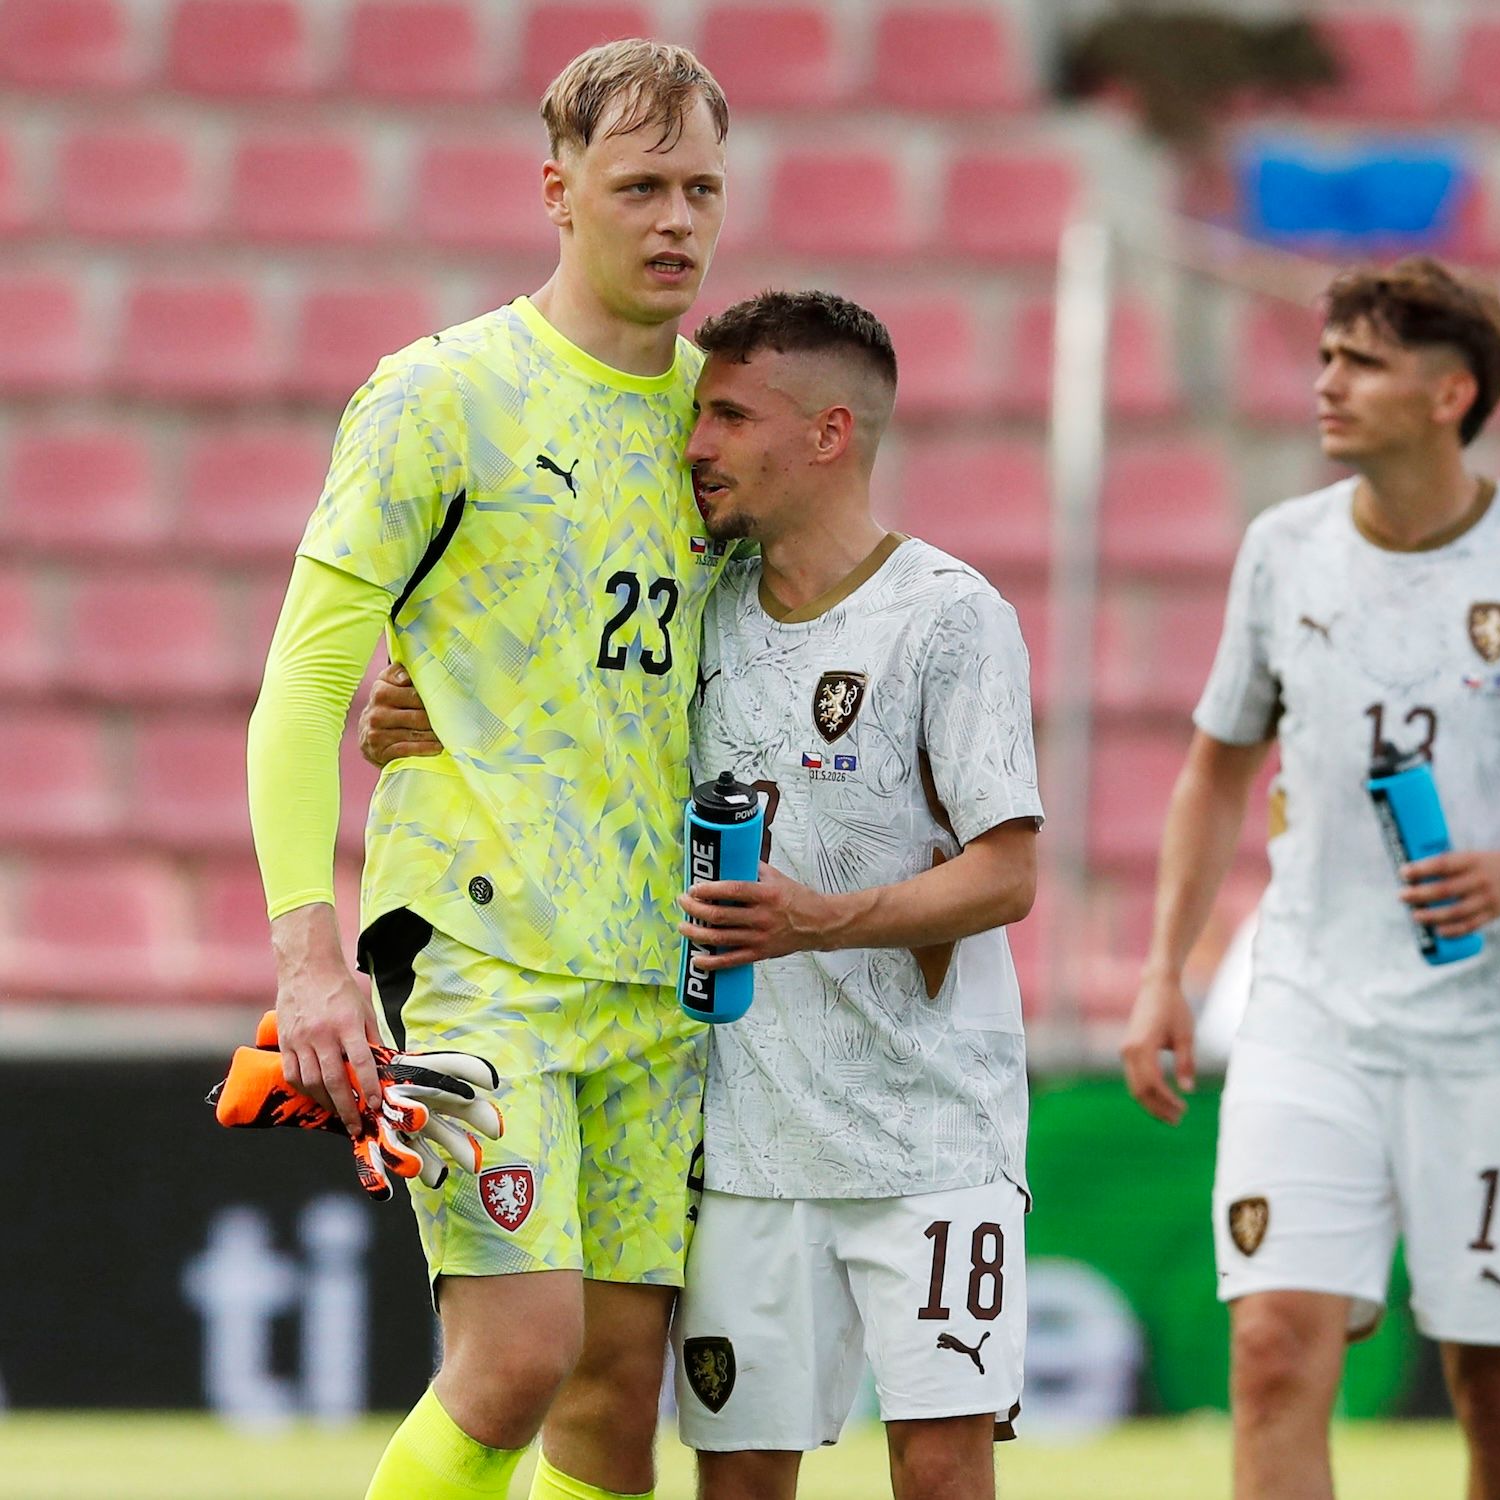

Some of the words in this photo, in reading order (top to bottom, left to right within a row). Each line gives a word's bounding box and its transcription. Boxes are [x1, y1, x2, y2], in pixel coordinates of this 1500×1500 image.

[596, 570, 680, 676] 23
[809, 769, 847, 782] 31.5.2026
[918, 1221, 1004, 1320] 18
